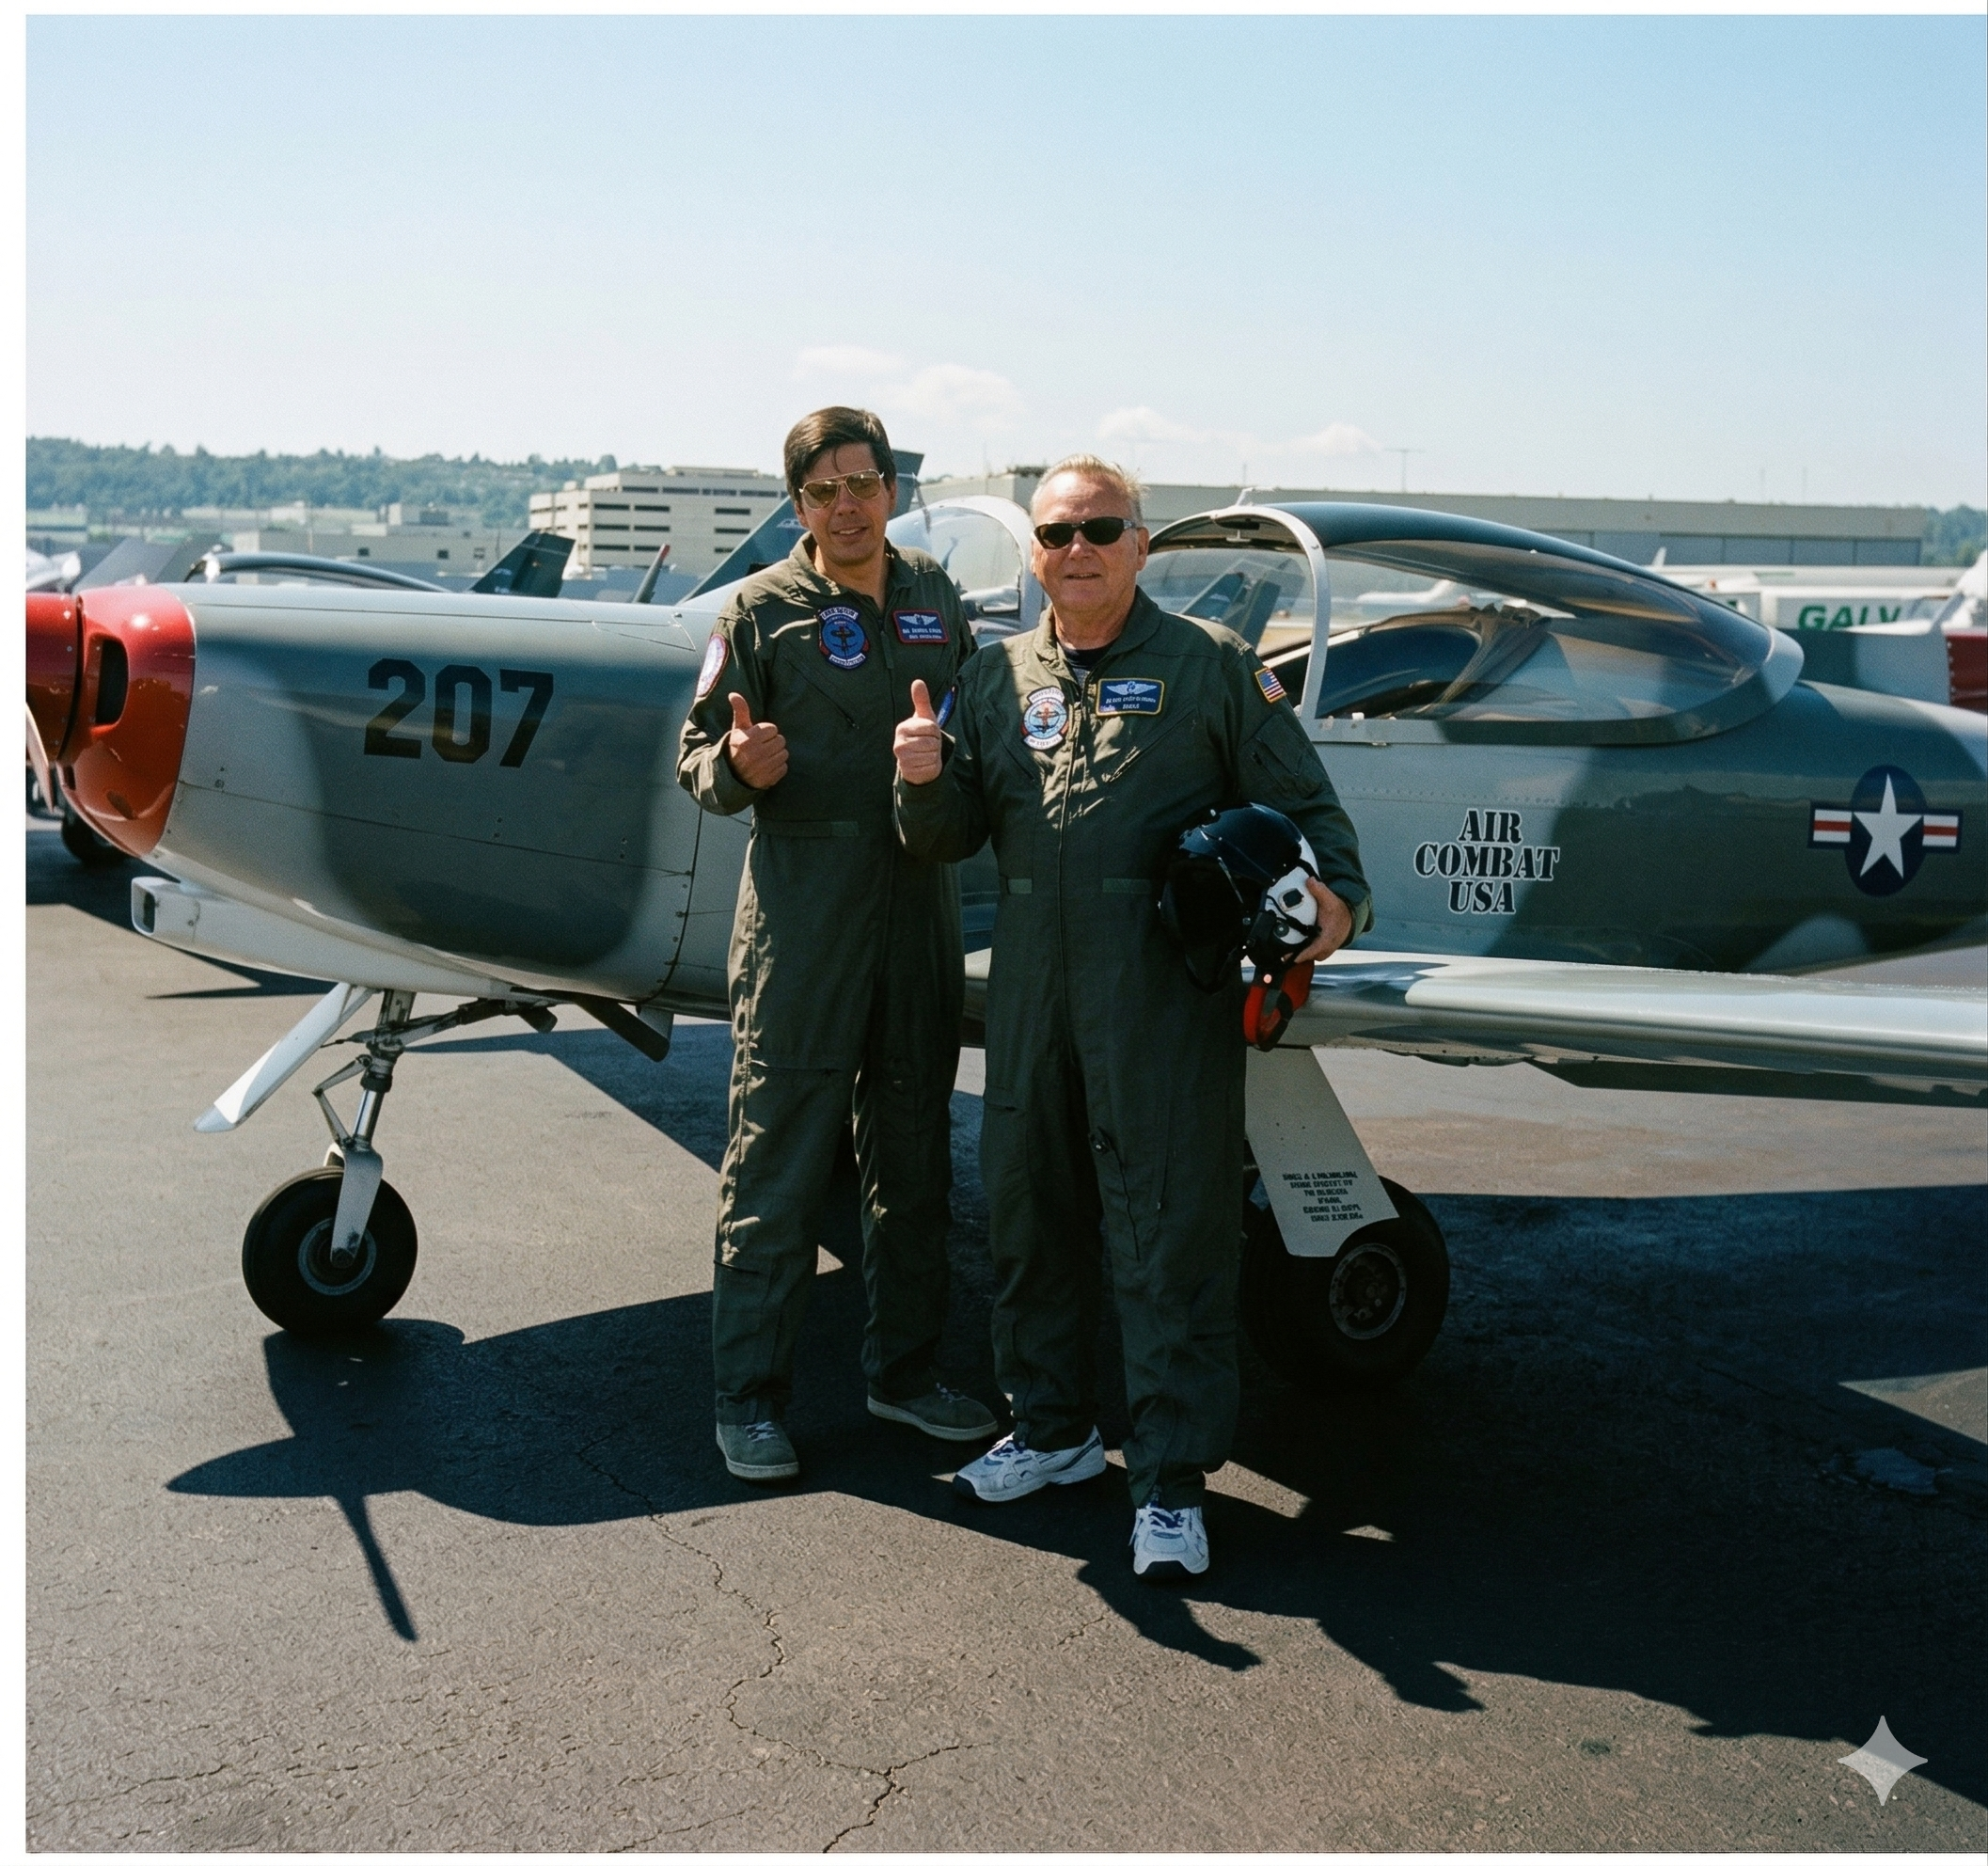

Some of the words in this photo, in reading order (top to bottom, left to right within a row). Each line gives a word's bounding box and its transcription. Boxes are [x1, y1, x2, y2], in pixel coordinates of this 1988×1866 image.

[364, 657, 554, 767] 207
[1458, 808, 1523, 846] AIR
[1413, 842, 1560, 880] COMBAT
[1448, 878, 1516, 914] USA
